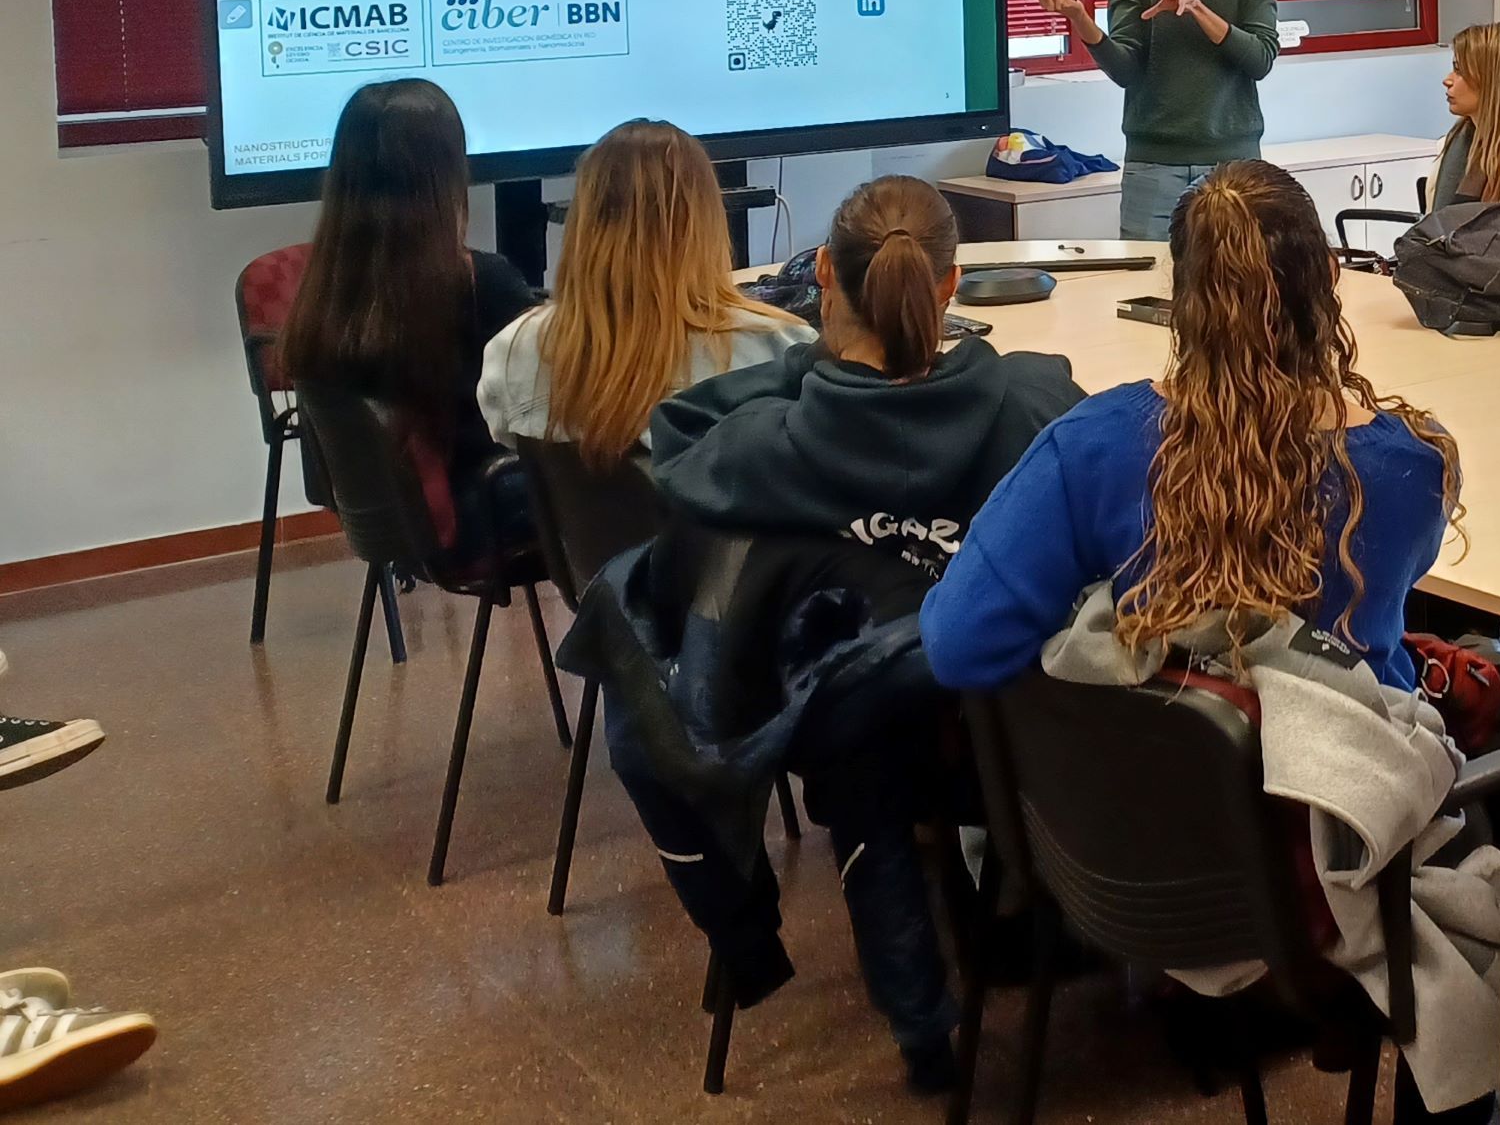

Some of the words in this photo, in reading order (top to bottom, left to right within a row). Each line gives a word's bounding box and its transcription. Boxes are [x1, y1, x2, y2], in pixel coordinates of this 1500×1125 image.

[300, 3, 408, 30] ICMAB
[567, 1, 620, 24] BBN
[345, 39, 409, 57] CSIC
[235, 154, 300, 166] MATERIALS
[304, 151, 327, 161] FOR
